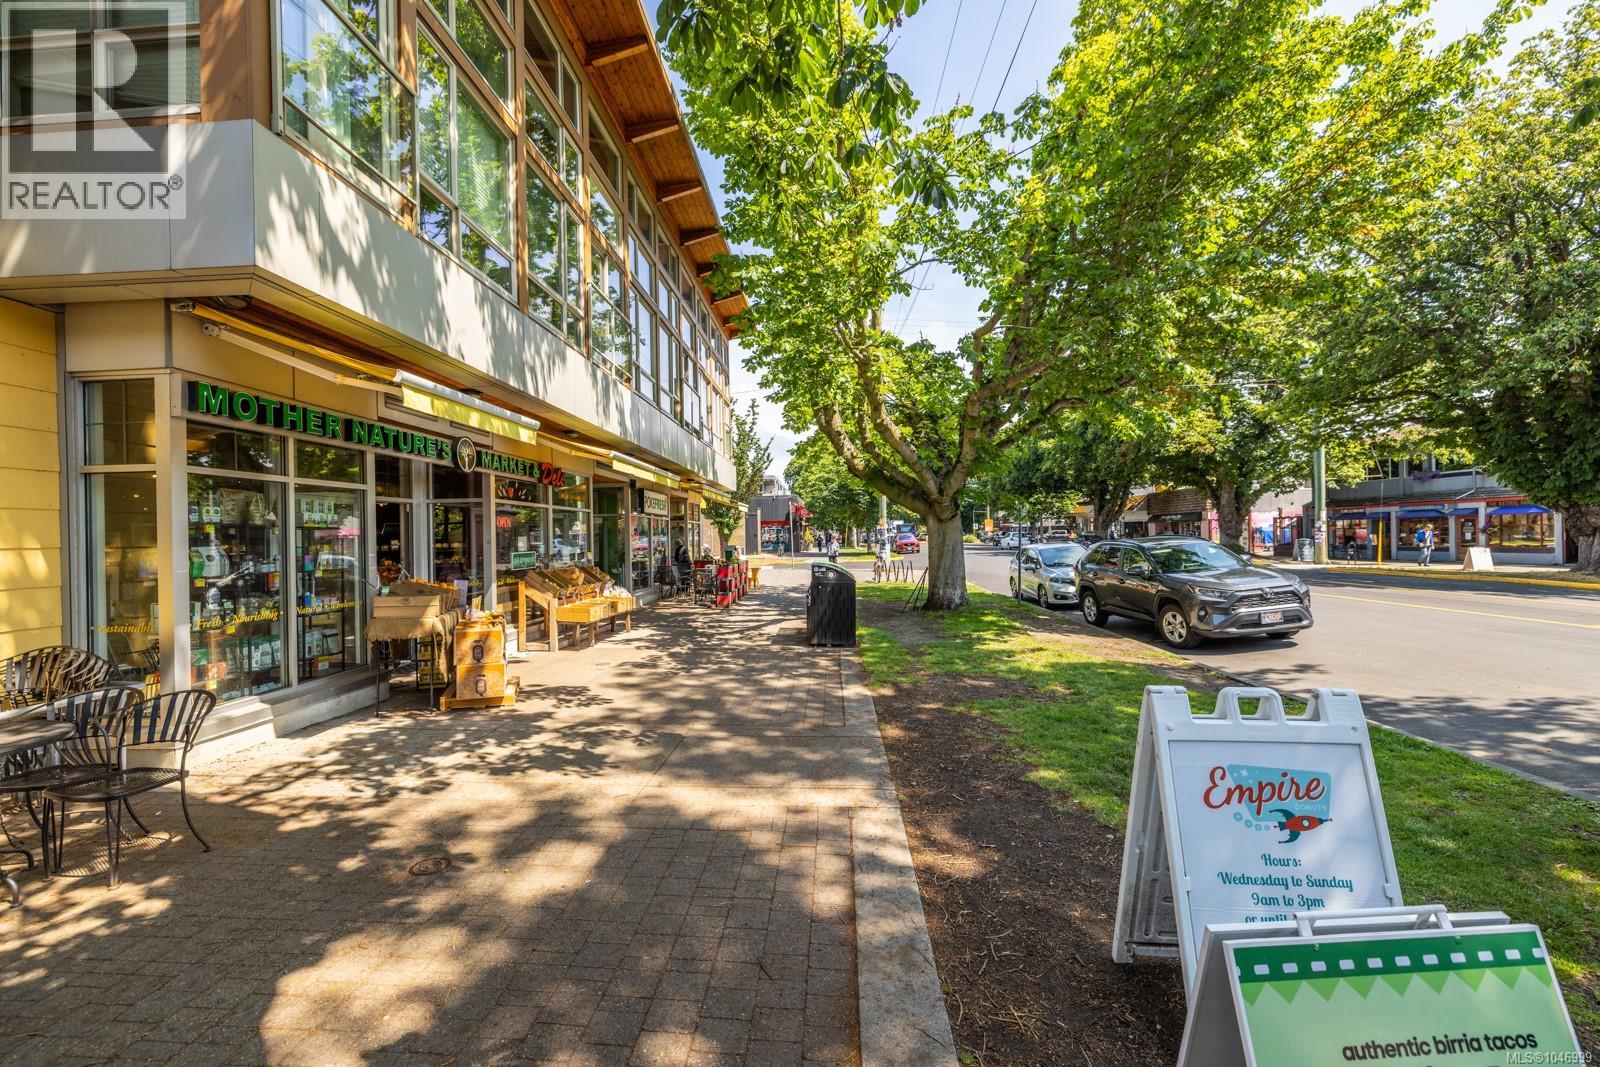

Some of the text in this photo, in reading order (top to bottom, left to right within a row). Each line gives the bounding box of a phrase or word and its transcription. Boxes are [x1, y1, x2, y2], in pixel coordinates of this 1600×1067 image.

[198, 381, 566, 486] MOTHER NATURE'S MARKET & Deli
[197, 609, 279, 629] Fresh Nourishing
[296, 603, 323, 615] Natural
[1203, 766, 1326, 816] Empire
[1261, 853, 1302, 867] Hours:
[1217, 871, 1354, 892] Wednesday to Sunday
[1251, 892, 1326, 910] 9am to 3pm
[1342, 1032, 1539, 1061] authentic birria tacos
